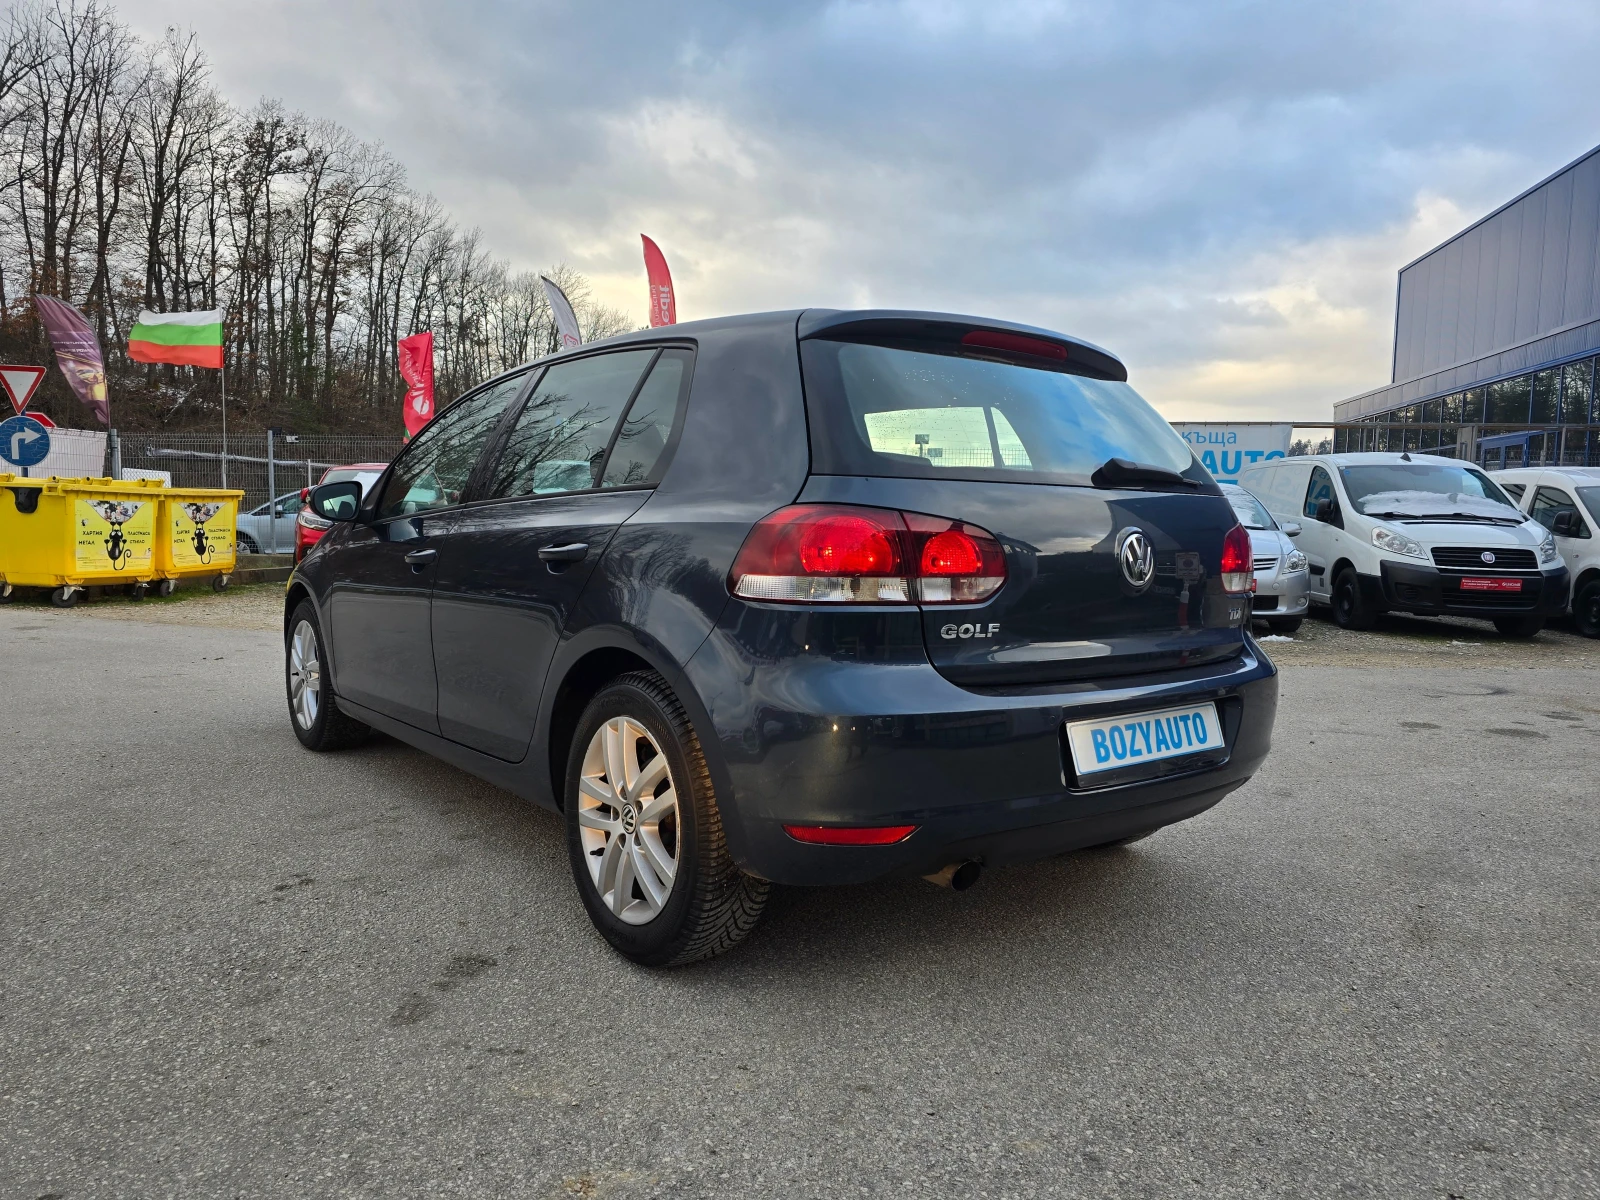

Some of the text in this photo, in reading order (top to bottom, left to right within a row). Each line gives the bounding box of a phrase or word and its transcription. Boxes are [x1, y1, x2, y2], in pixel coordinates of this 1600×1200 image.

[1181, 431, 1237, 447] къща
[940, 623, 1000, 639] GOLF
[1090, 712, 1208, 764] BOZYAUTO
